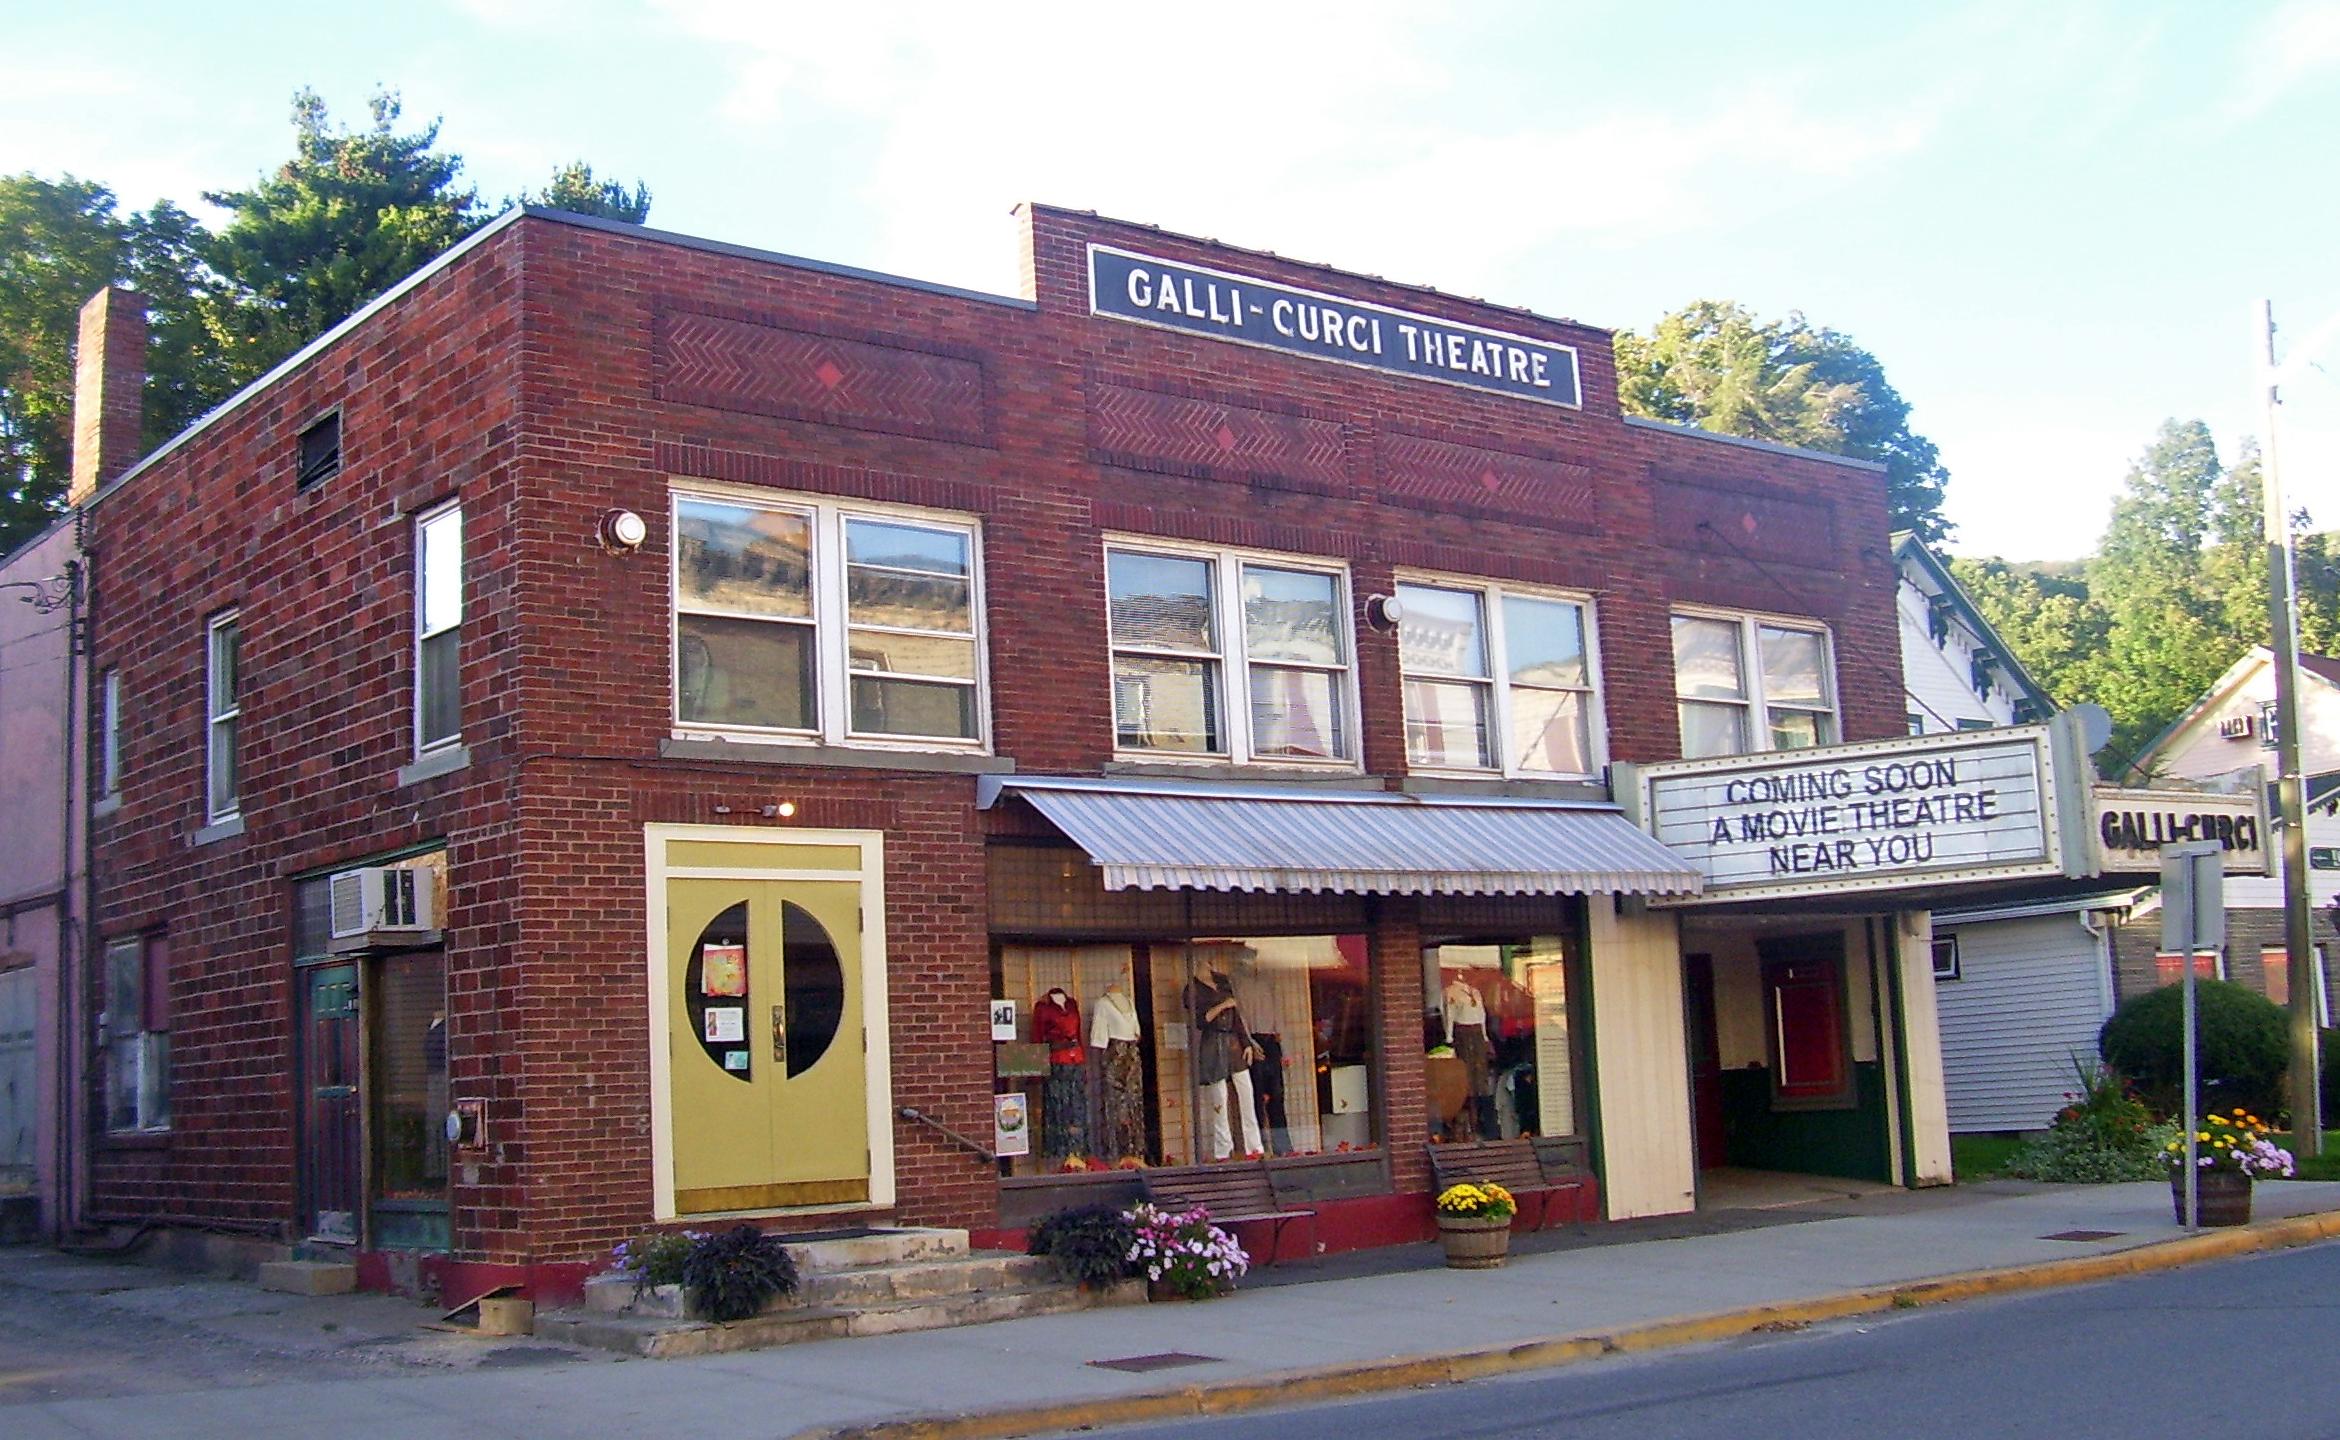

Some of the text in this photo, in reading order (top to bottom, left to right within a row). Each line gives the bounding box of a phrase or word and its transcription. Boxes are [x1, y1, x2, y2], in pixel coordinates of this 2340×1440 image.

[1128, 268, 1552, 388] GALLI-CURCI THEATRE
[1726, 756, 1957, 806] COMING SOON
[1712, 789, 2000, 846] A MOVIE THEATRE
[1769, 832, 1934, 875] NEAR YOU
